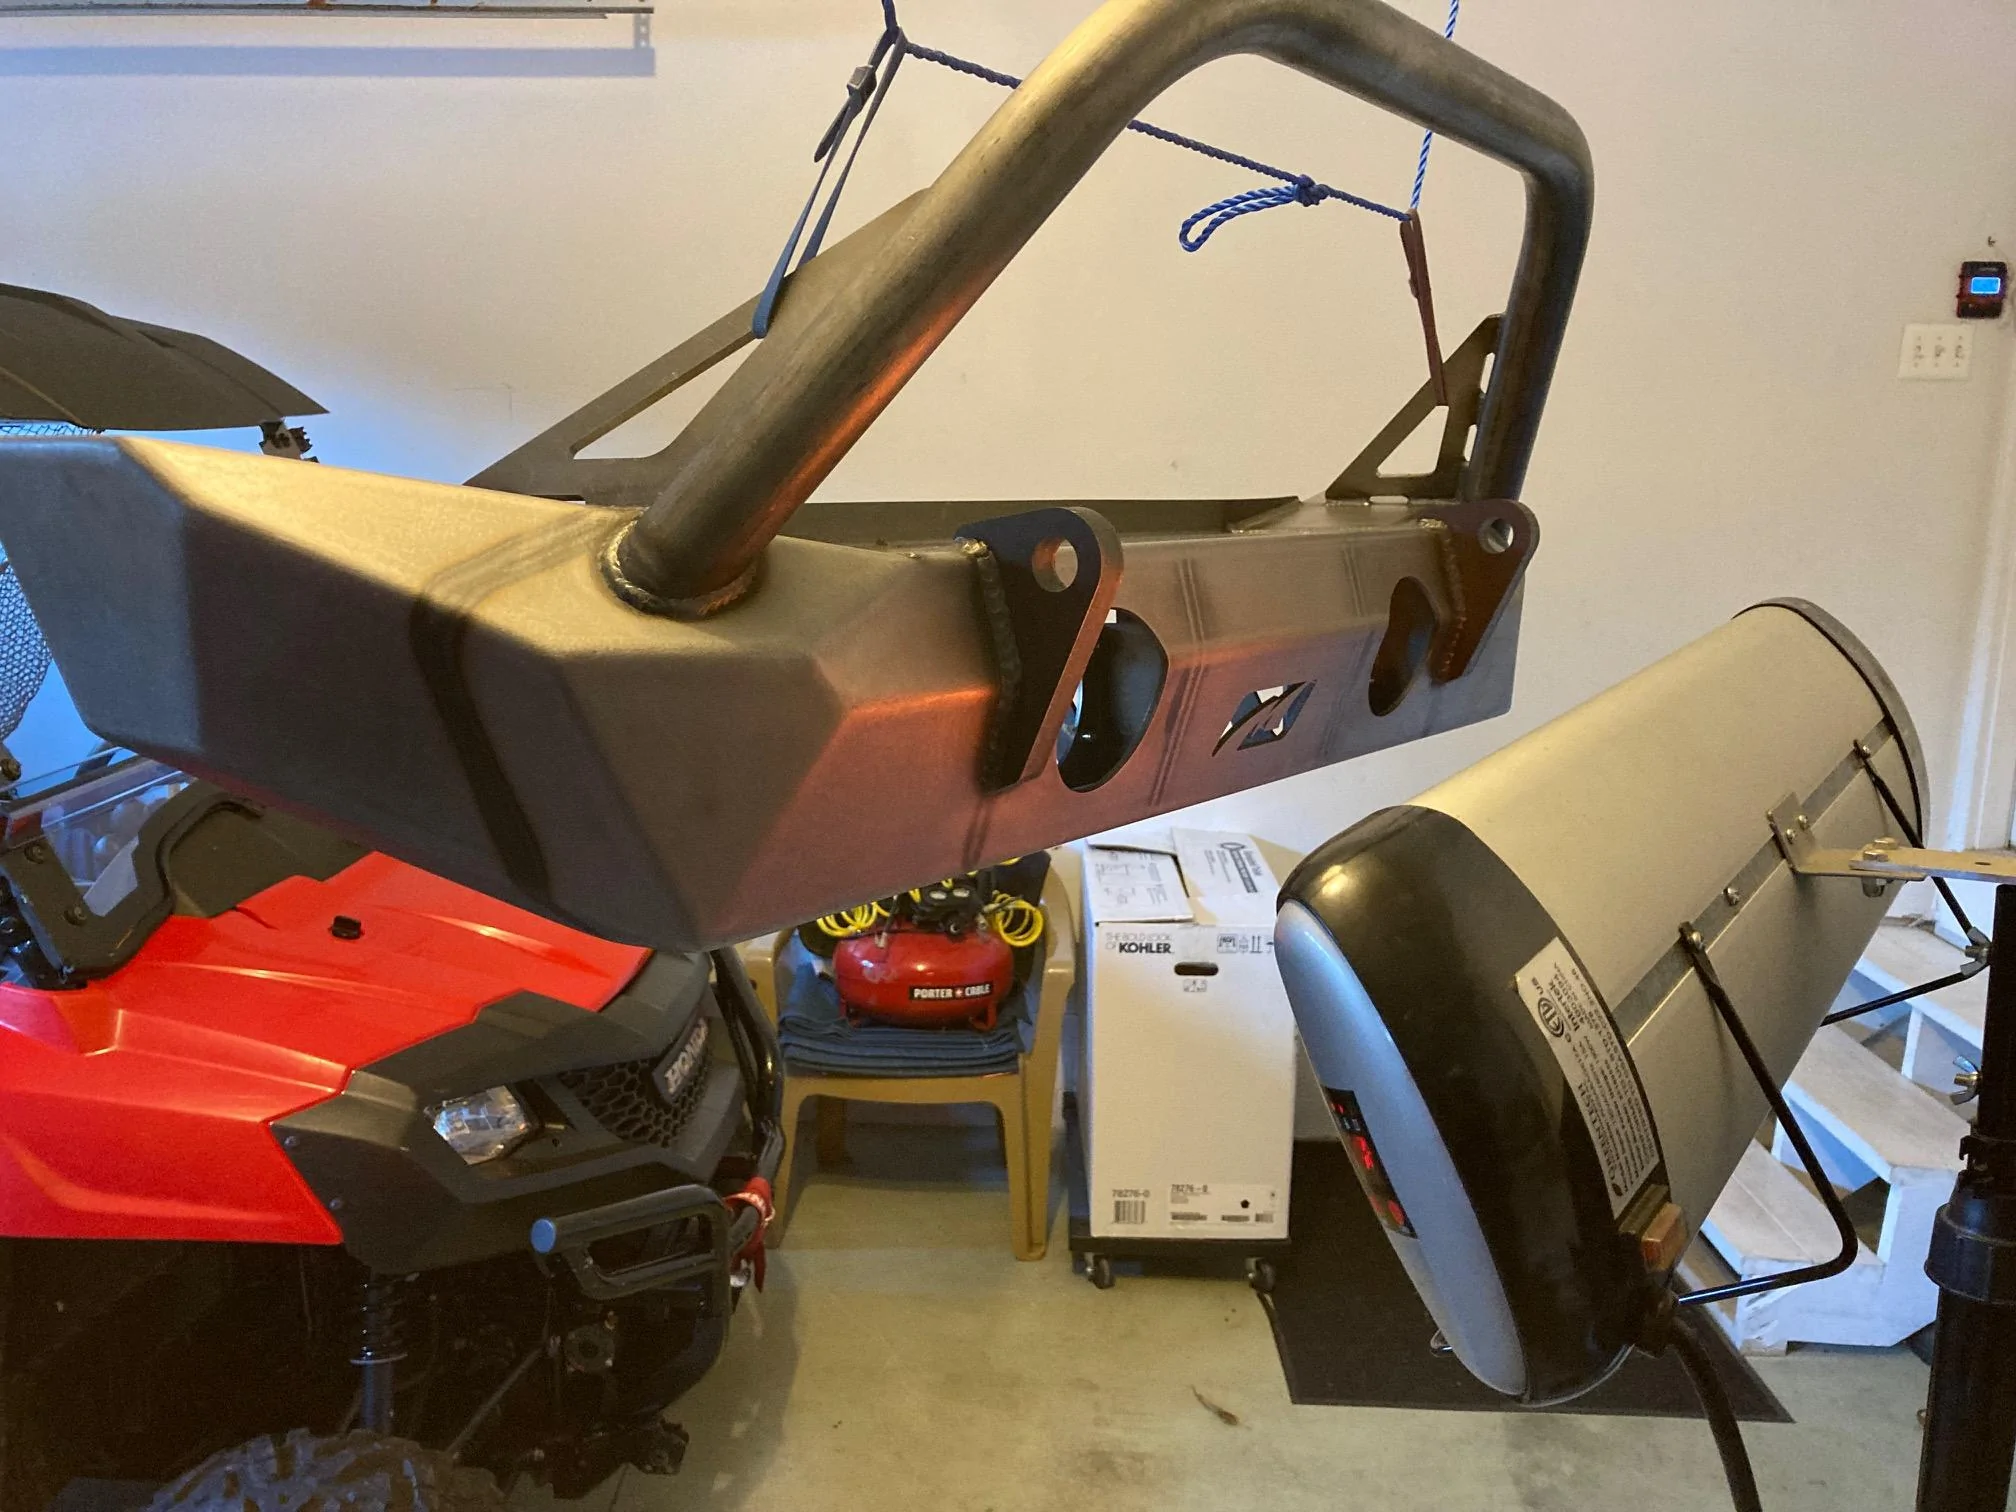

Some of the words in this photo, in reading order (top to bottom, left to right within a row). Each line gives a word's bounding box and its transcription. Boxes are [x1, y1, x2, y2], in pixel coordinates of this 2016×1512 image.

[1119, 942, 1172, 954] KOHLER
[913, 988, 953, 998] PORTER
[964, 984, 990, 996] CABLE
[1549, 981, 1580, 1031] Intertek
[664, 1016, 708, 1094] HONDA
